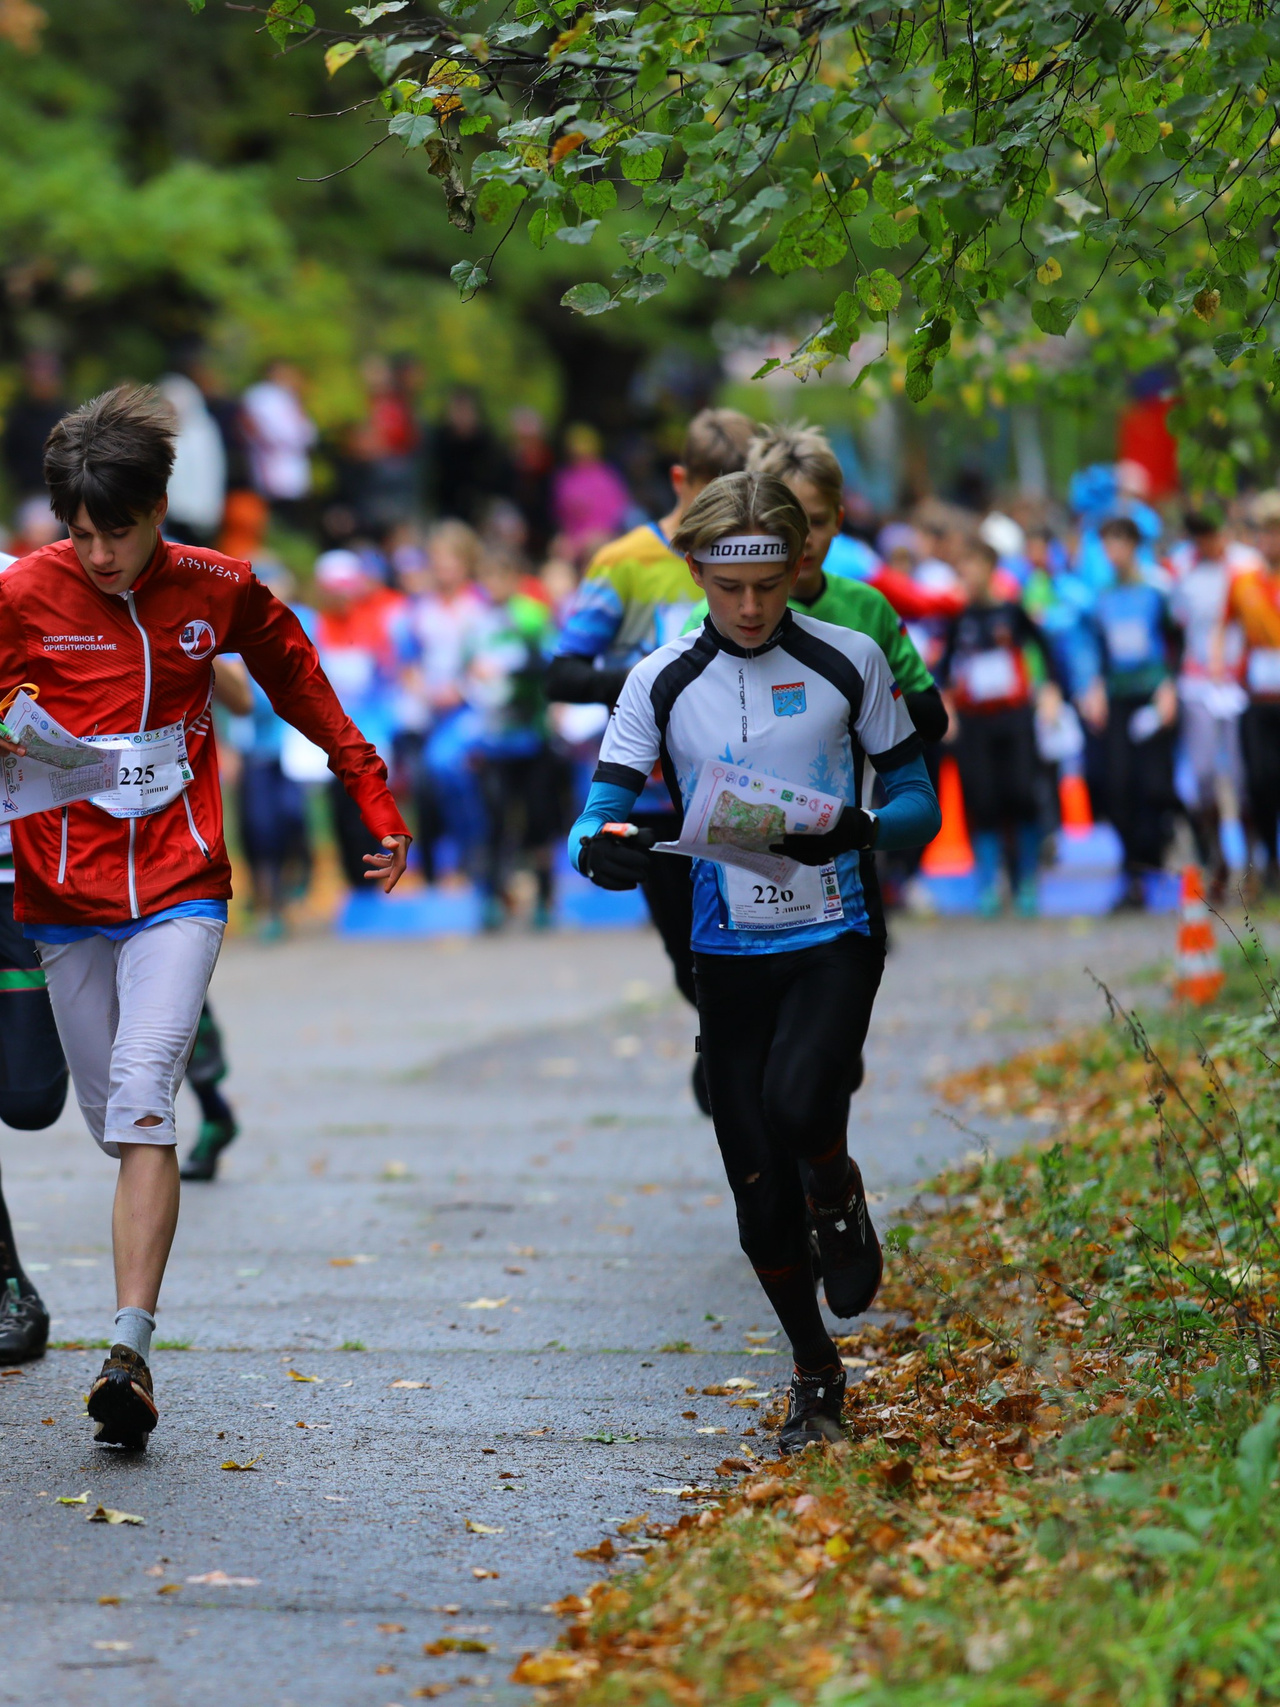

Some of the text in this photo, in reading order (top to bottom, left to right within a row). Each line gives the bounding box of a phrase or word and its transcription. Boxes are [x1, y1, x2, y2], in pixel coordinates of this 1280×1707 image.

[710, 542, 789, 557] noname
[42, 635, 96, 643] СПОРТИВНОЕ
[43, 643, 118, 651] ОРИЕНТИРОВАНИЕ
[738, 668, 746, 711] VICTORY
[119, 764, 155, 786] 225
[140, 785, 169, 796] 2 линия
[816, 803, 834, 828] 226.2
[782, 904, 811, 914] линия
